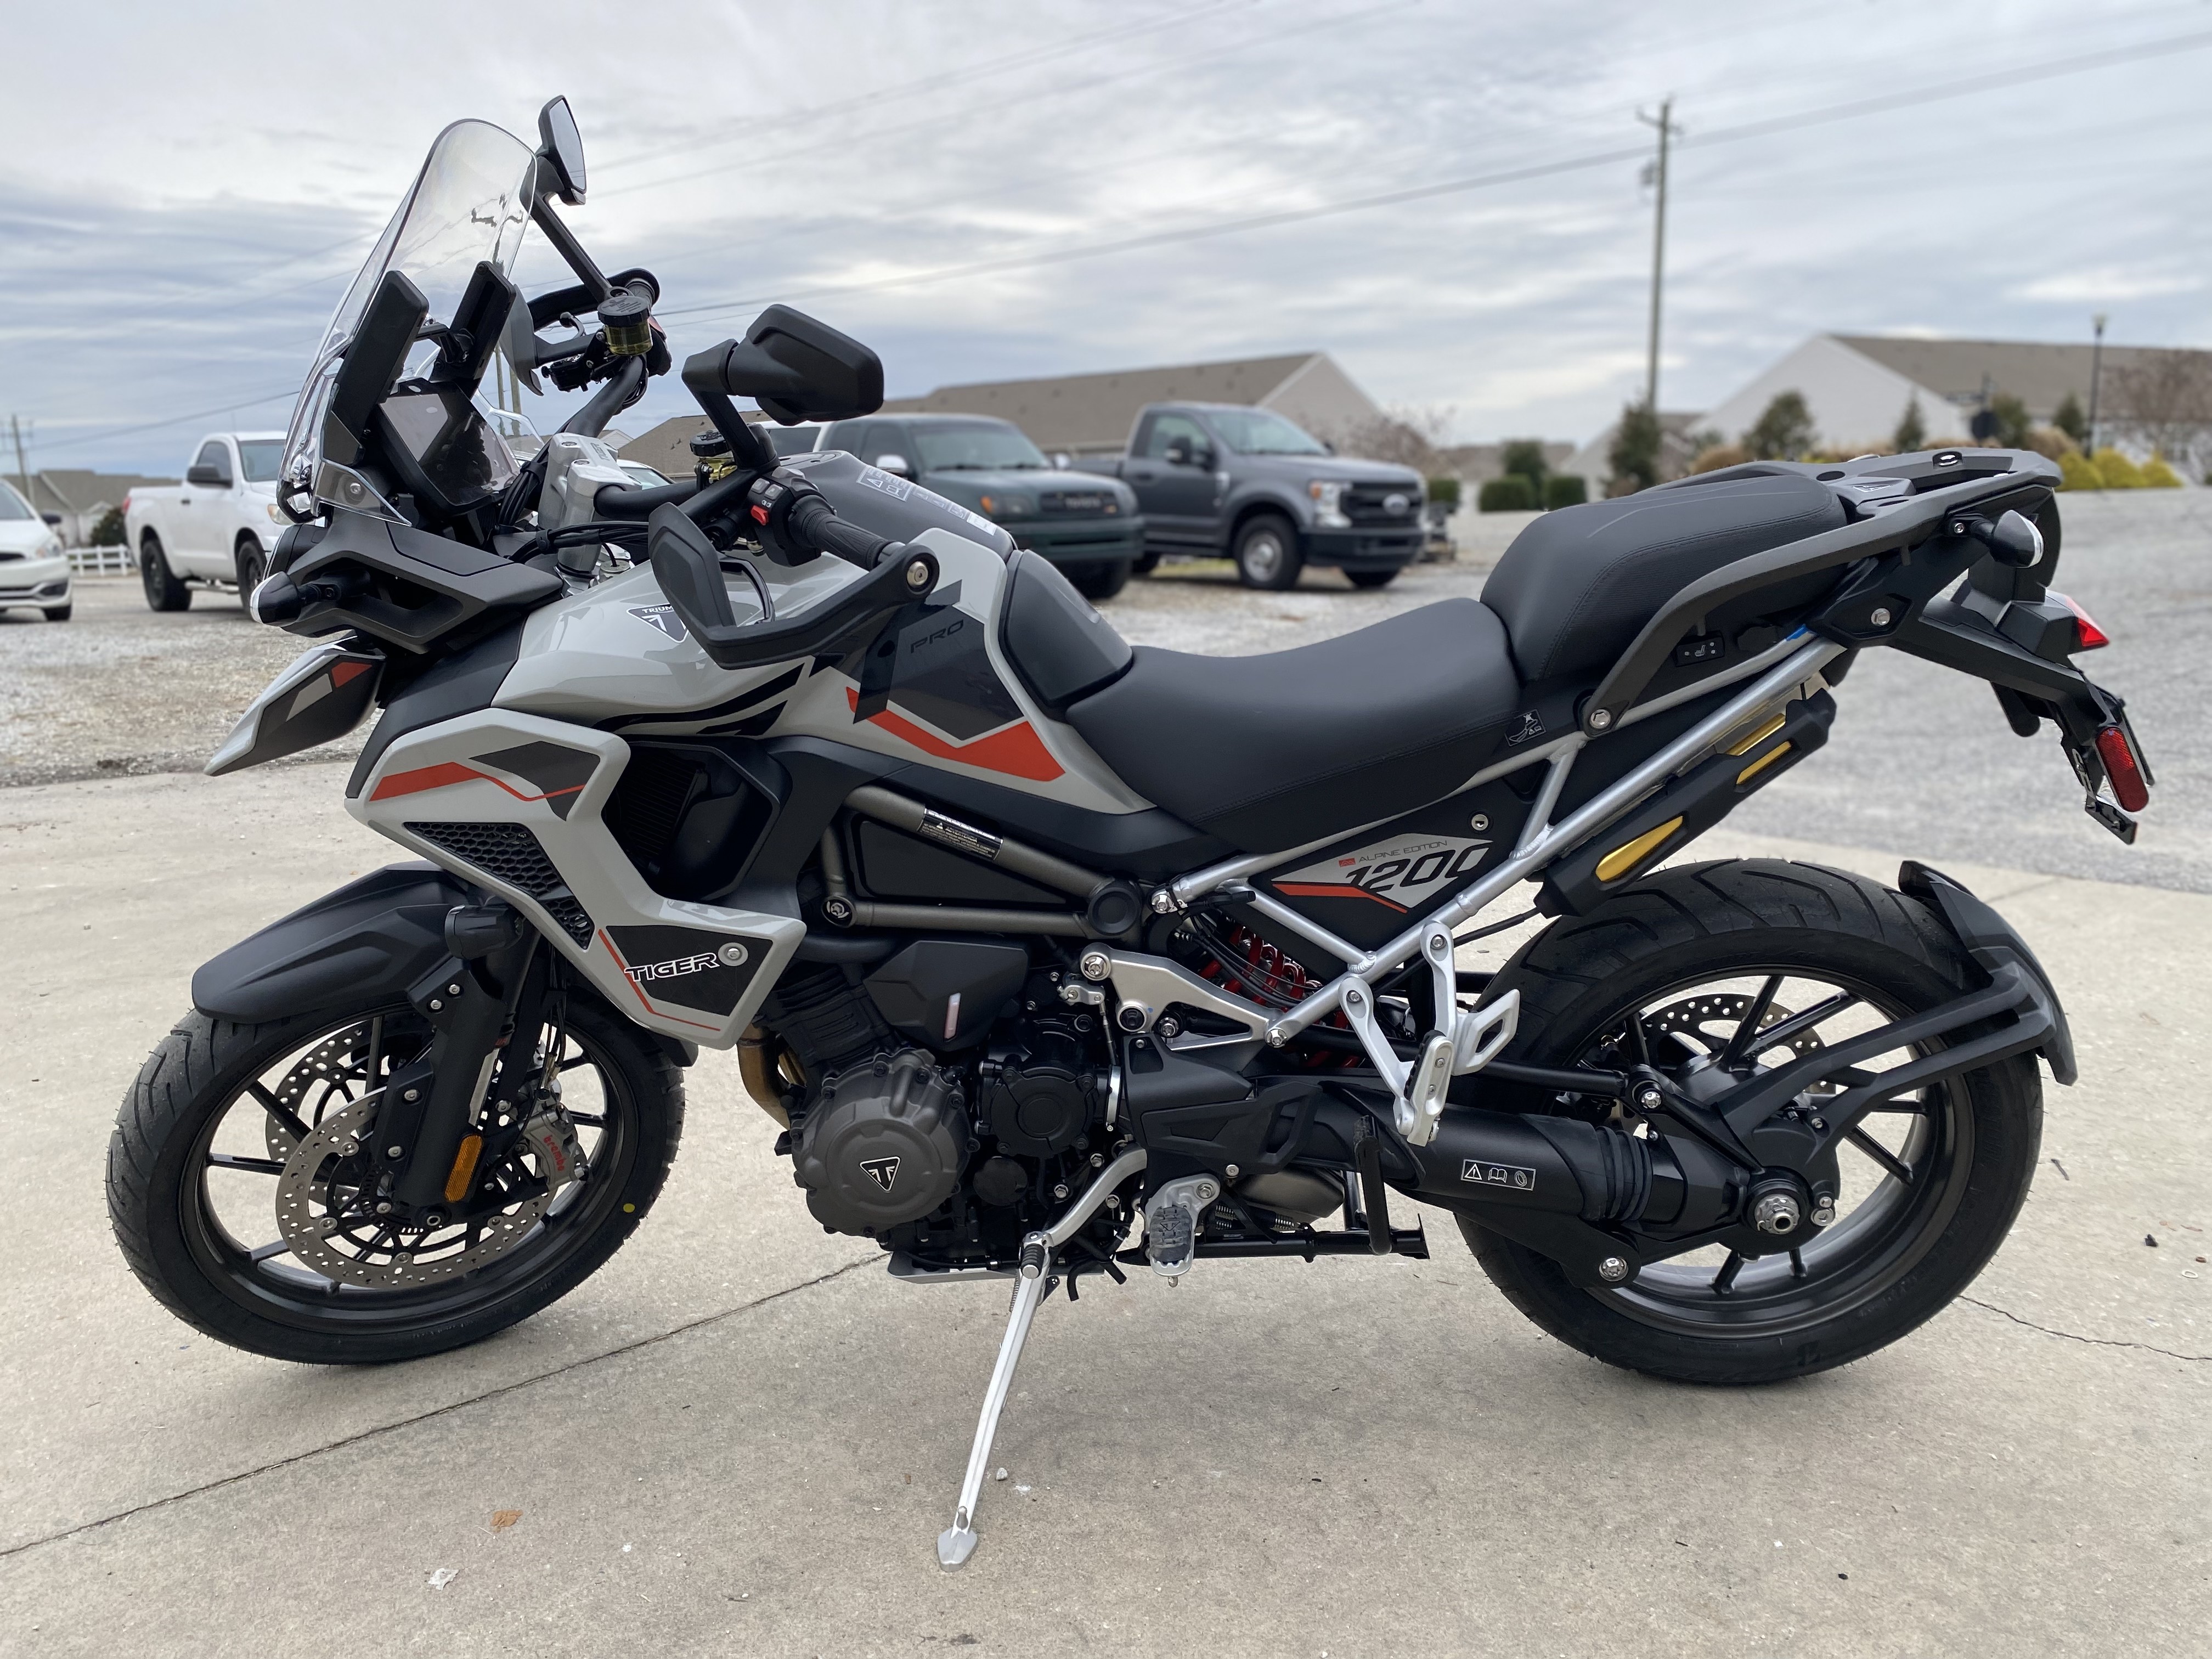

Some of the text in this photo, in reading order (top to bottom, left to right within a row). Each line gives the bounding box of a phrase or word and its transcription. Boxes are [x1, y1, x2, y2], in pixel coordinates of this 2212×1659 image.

[641, 605, 674, 613] TRIUM
[911, 619, 964, 654] PRO
[1358, 840, 1448, 864] ALPINE EDITION
[623, 952, 720, 982] TIGER
[543, 1134, 566, 1171] brembo
